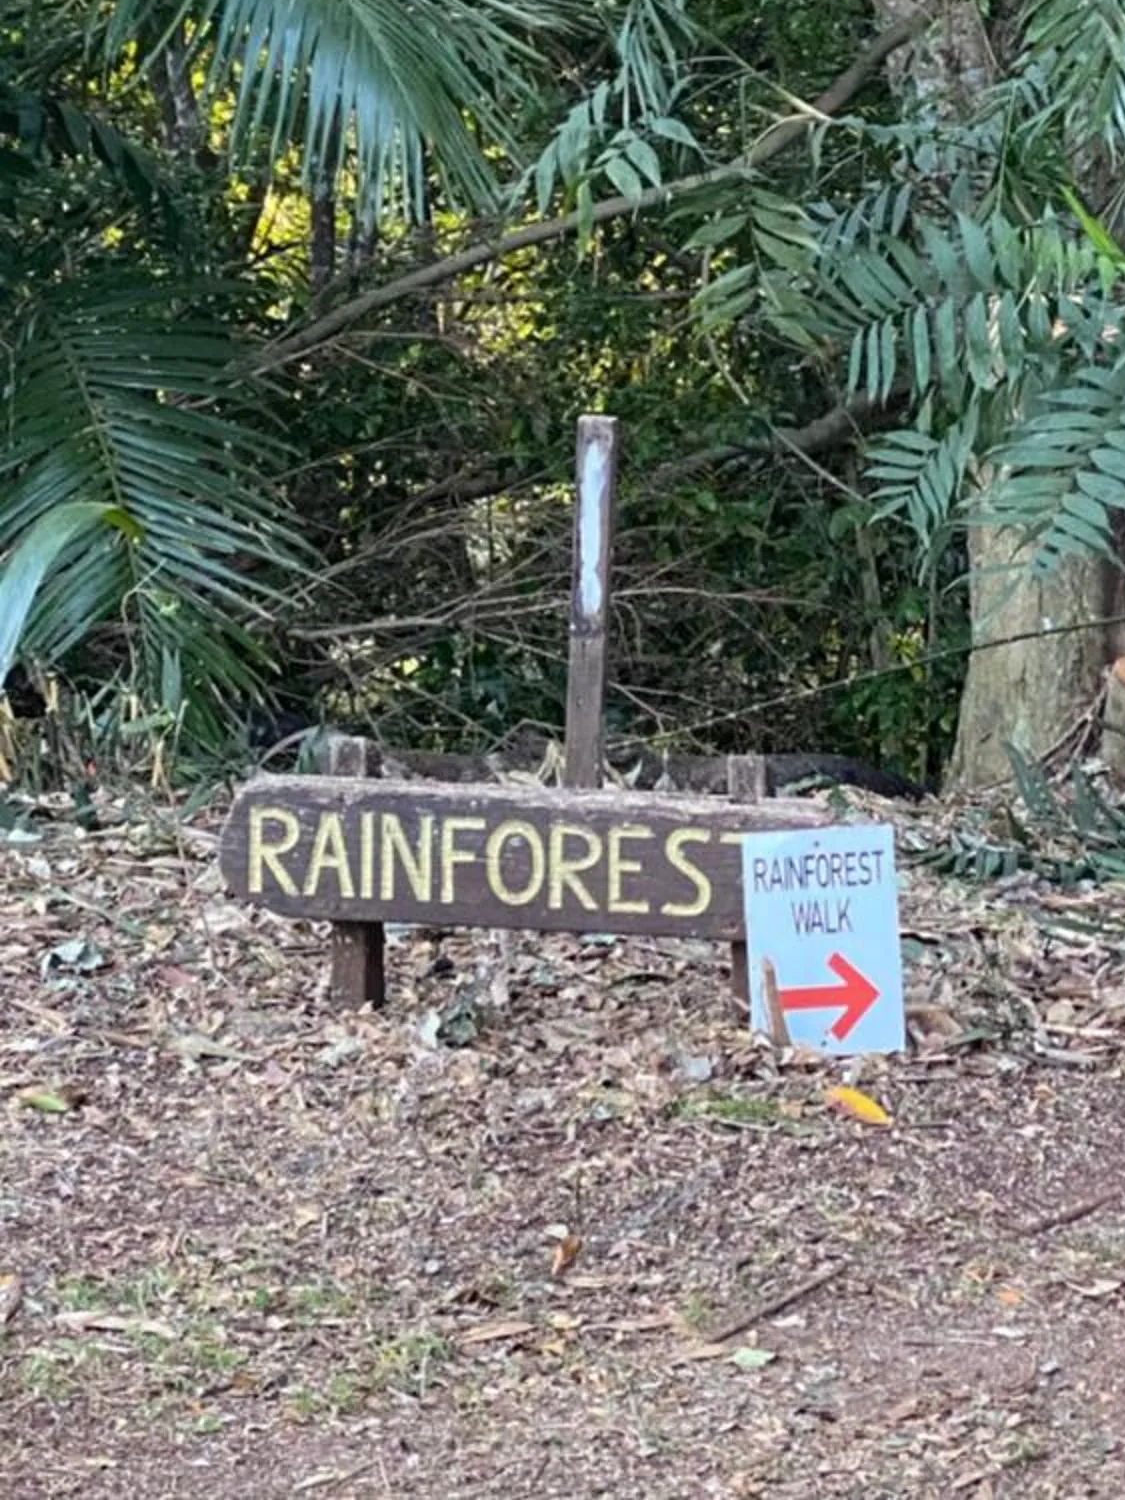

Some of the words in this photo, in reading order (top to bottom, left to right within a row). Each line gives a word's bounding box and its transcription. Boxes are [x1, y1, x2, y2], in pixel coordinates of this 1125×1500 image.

[247, 806, 742, 917] RAINFORES
[753, 850, 885, 893] RAINFOREST
[791, 899, 853, 935] WALK
